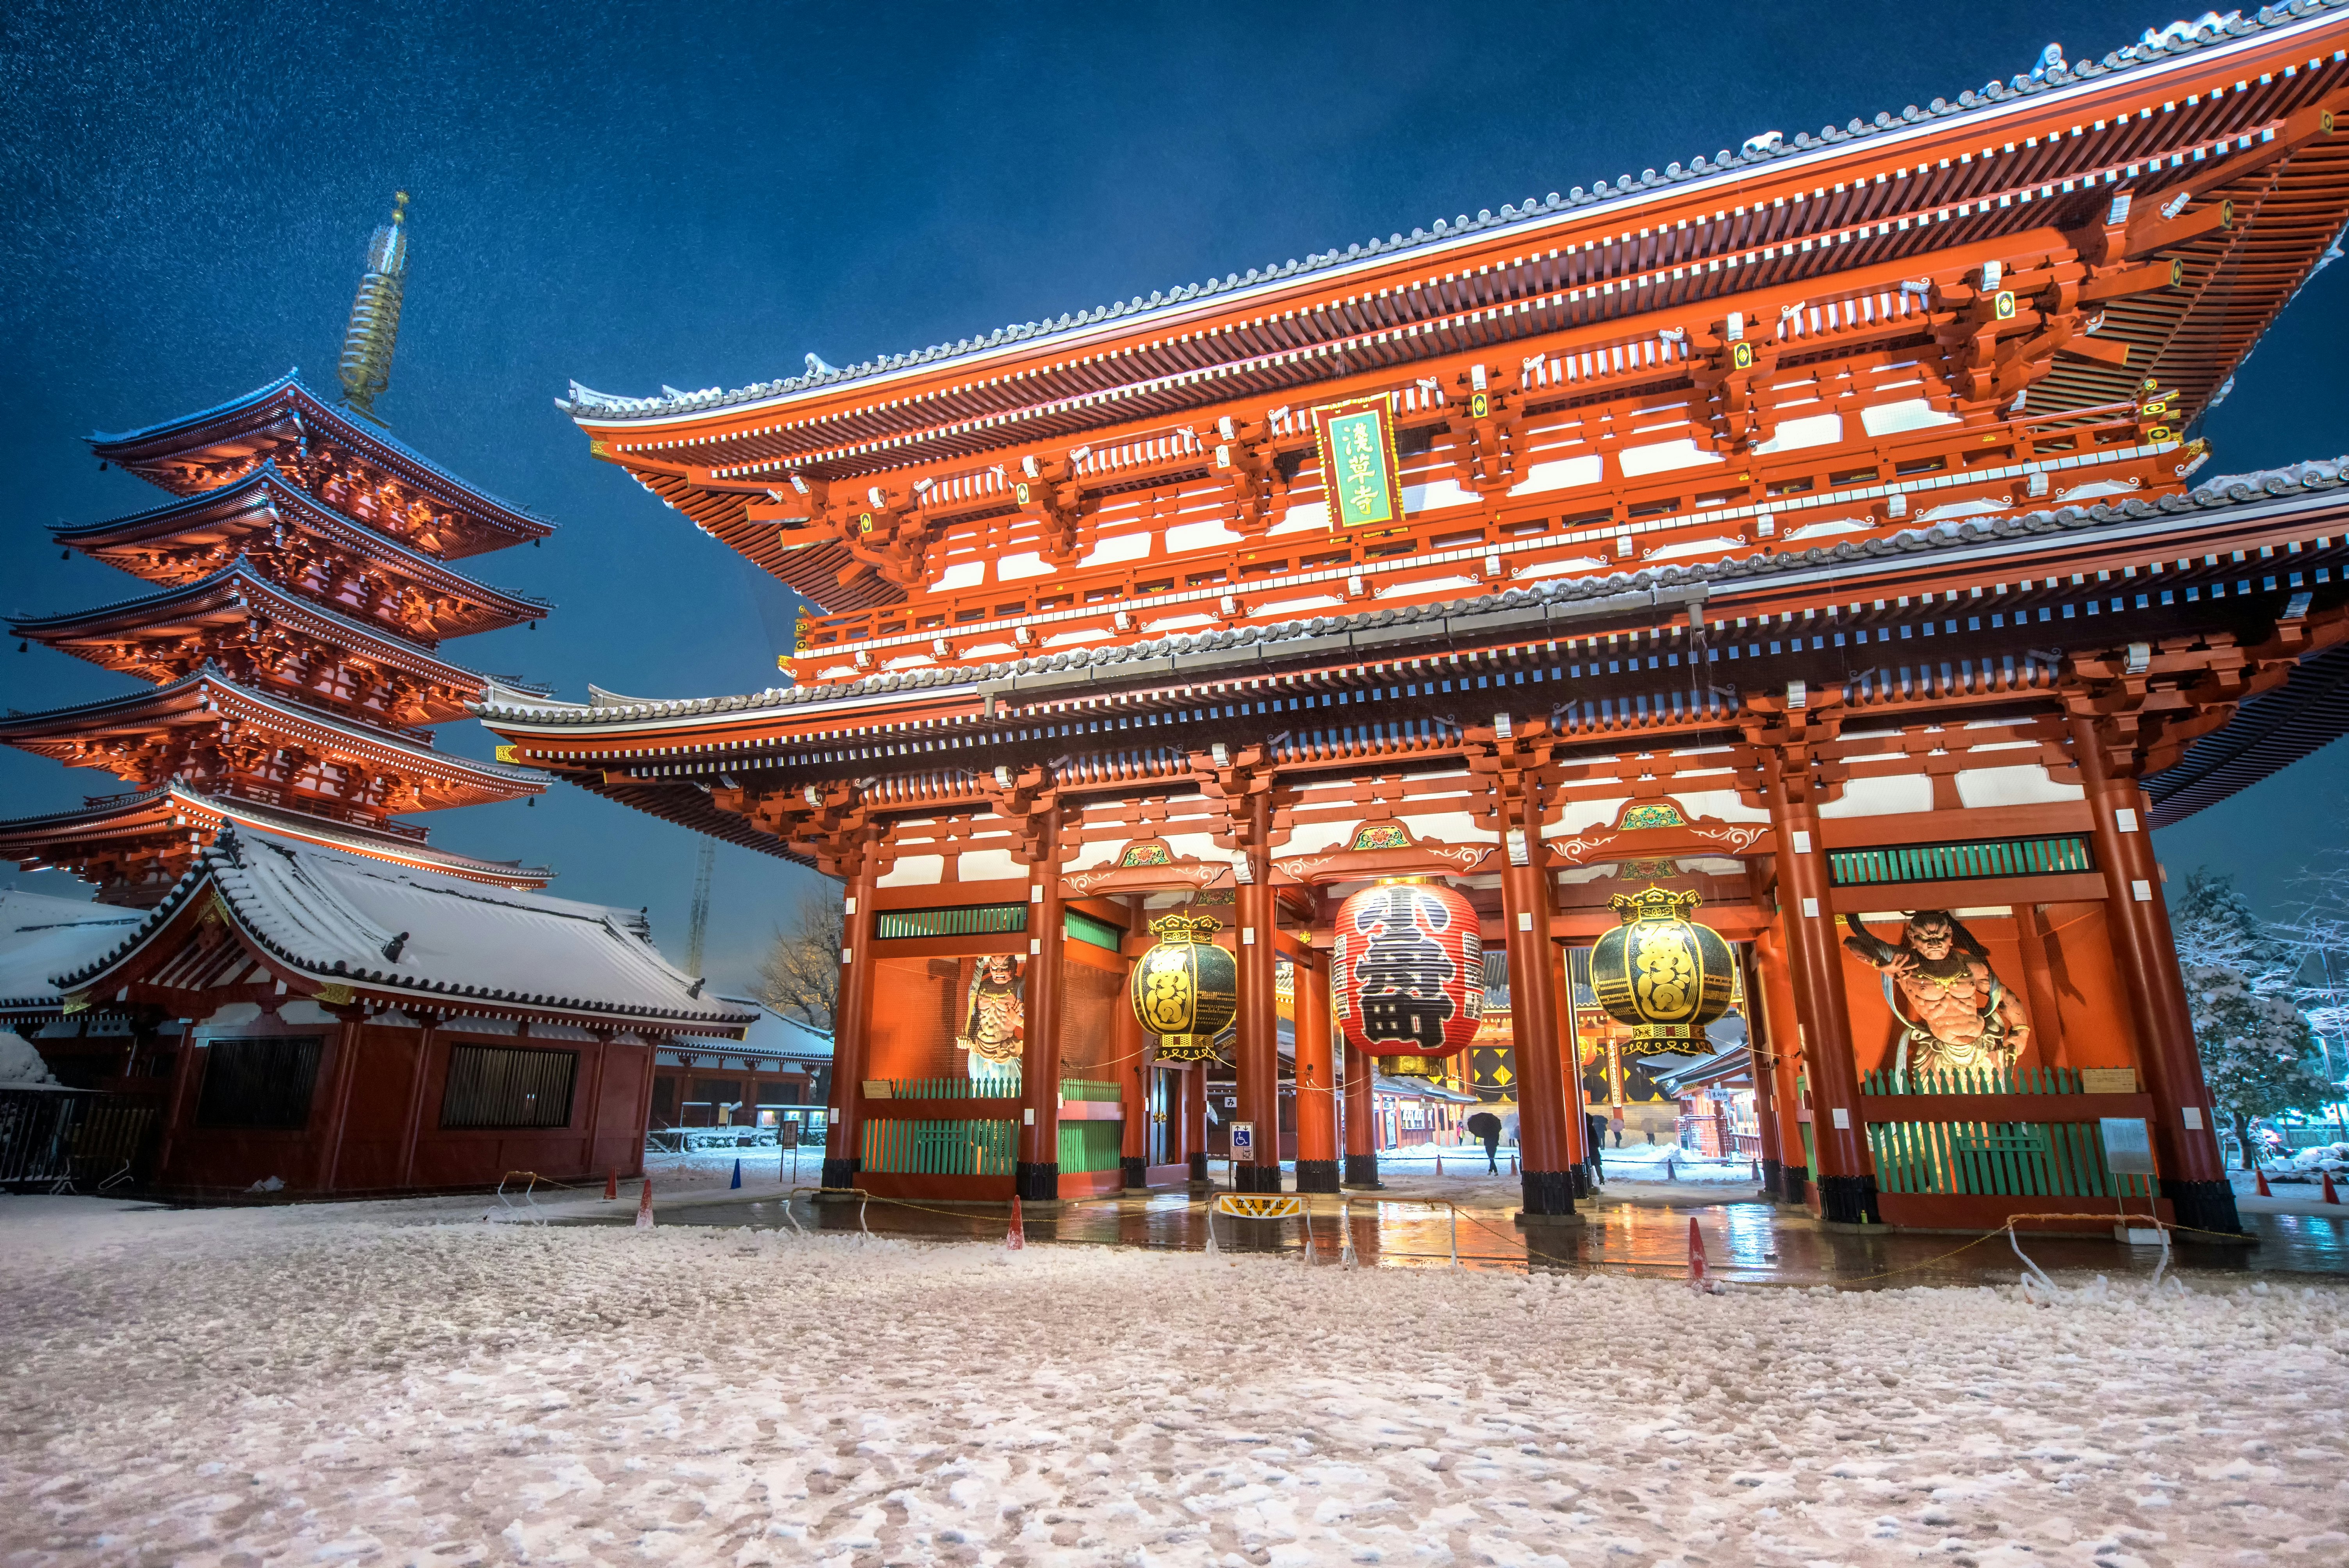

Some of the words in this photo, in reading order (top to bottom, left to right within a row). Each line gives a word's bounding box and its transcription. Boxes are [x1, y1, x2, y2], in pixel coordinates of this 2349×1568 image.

[1354, 886, 1456, 1049] 小舟町
[1235, 1199, 1284, 1209] 立入禁止
